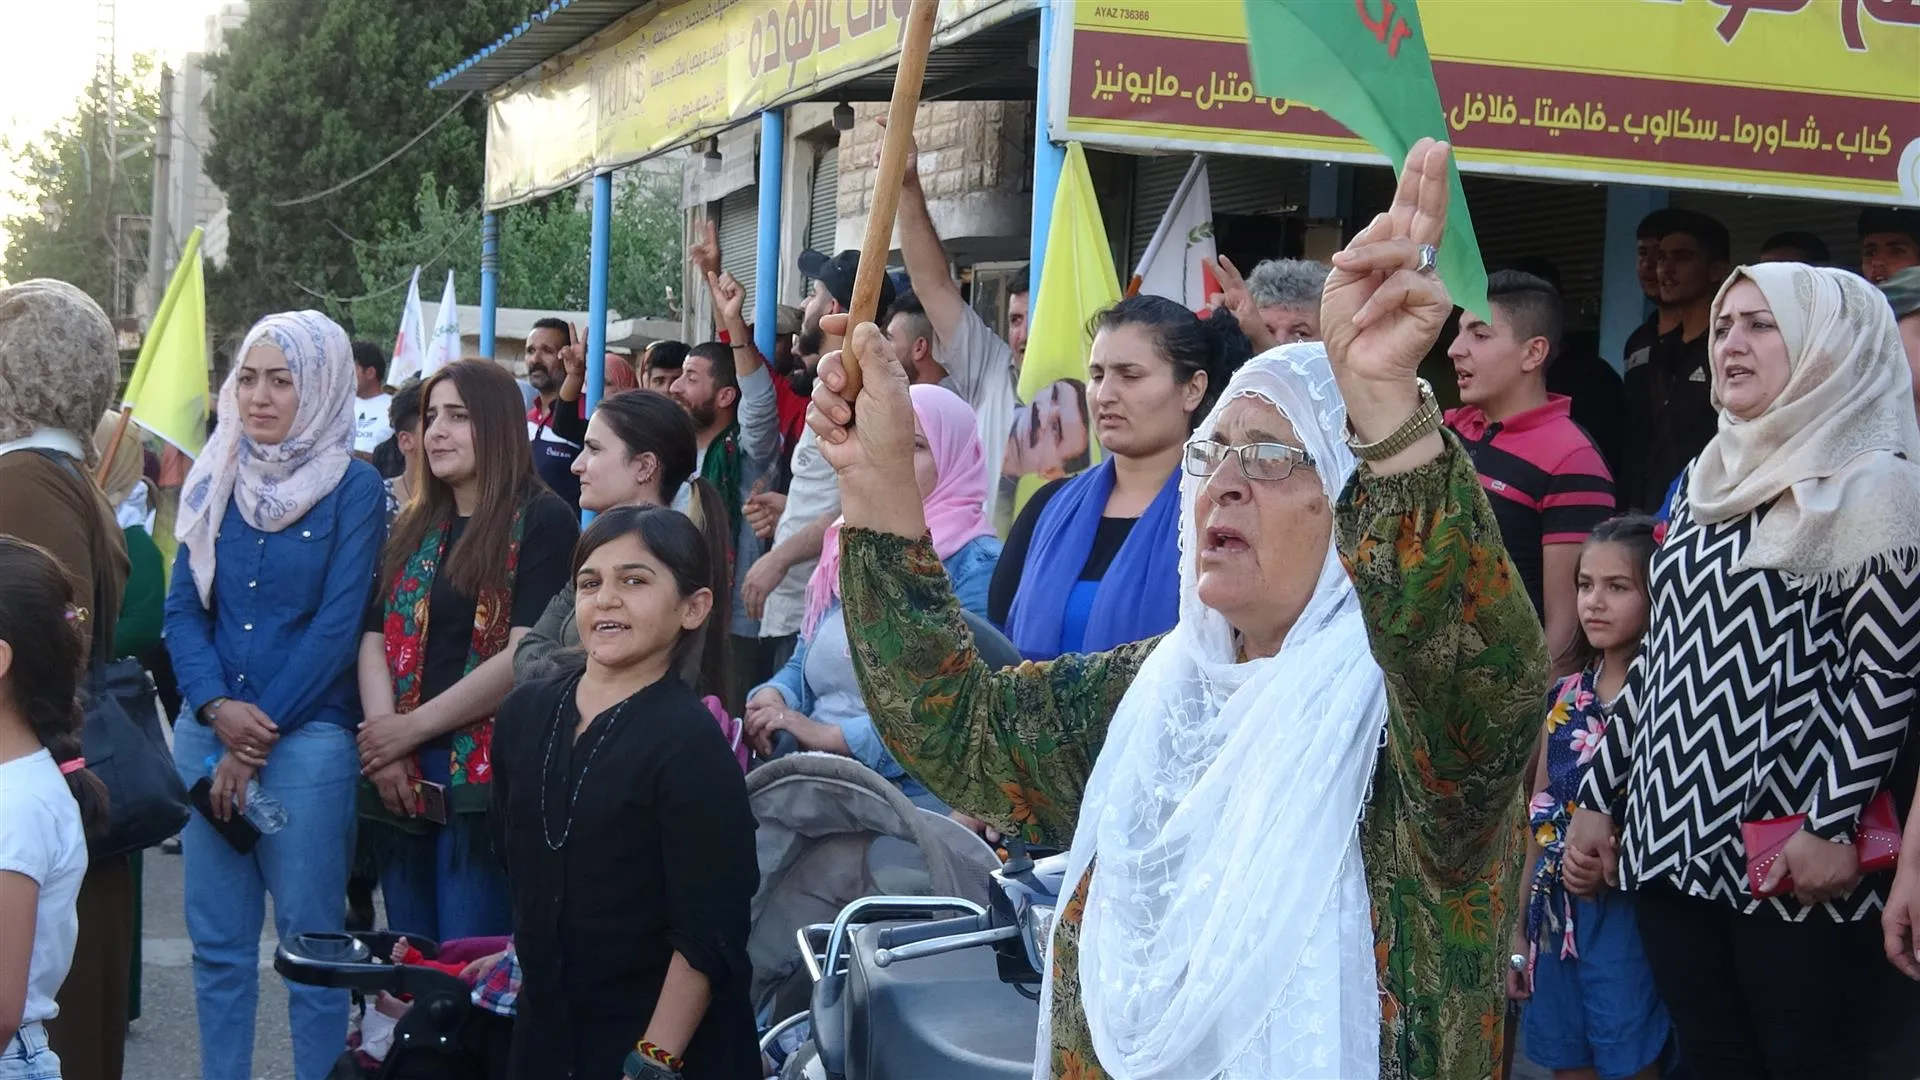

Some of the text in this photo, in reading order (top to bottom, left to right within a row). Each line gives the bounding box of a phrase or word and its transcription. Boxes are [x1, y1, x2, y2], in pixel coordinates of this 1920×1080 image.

[1094, 6, 1118, 19] AYAZ
[1090, 59, 1180, 103] مايونيز
[1195, 70, 1254, 111] متبل
[1450, 92, 1892, 162] كباب شاورما سكالوب فاهيتا فلافل
